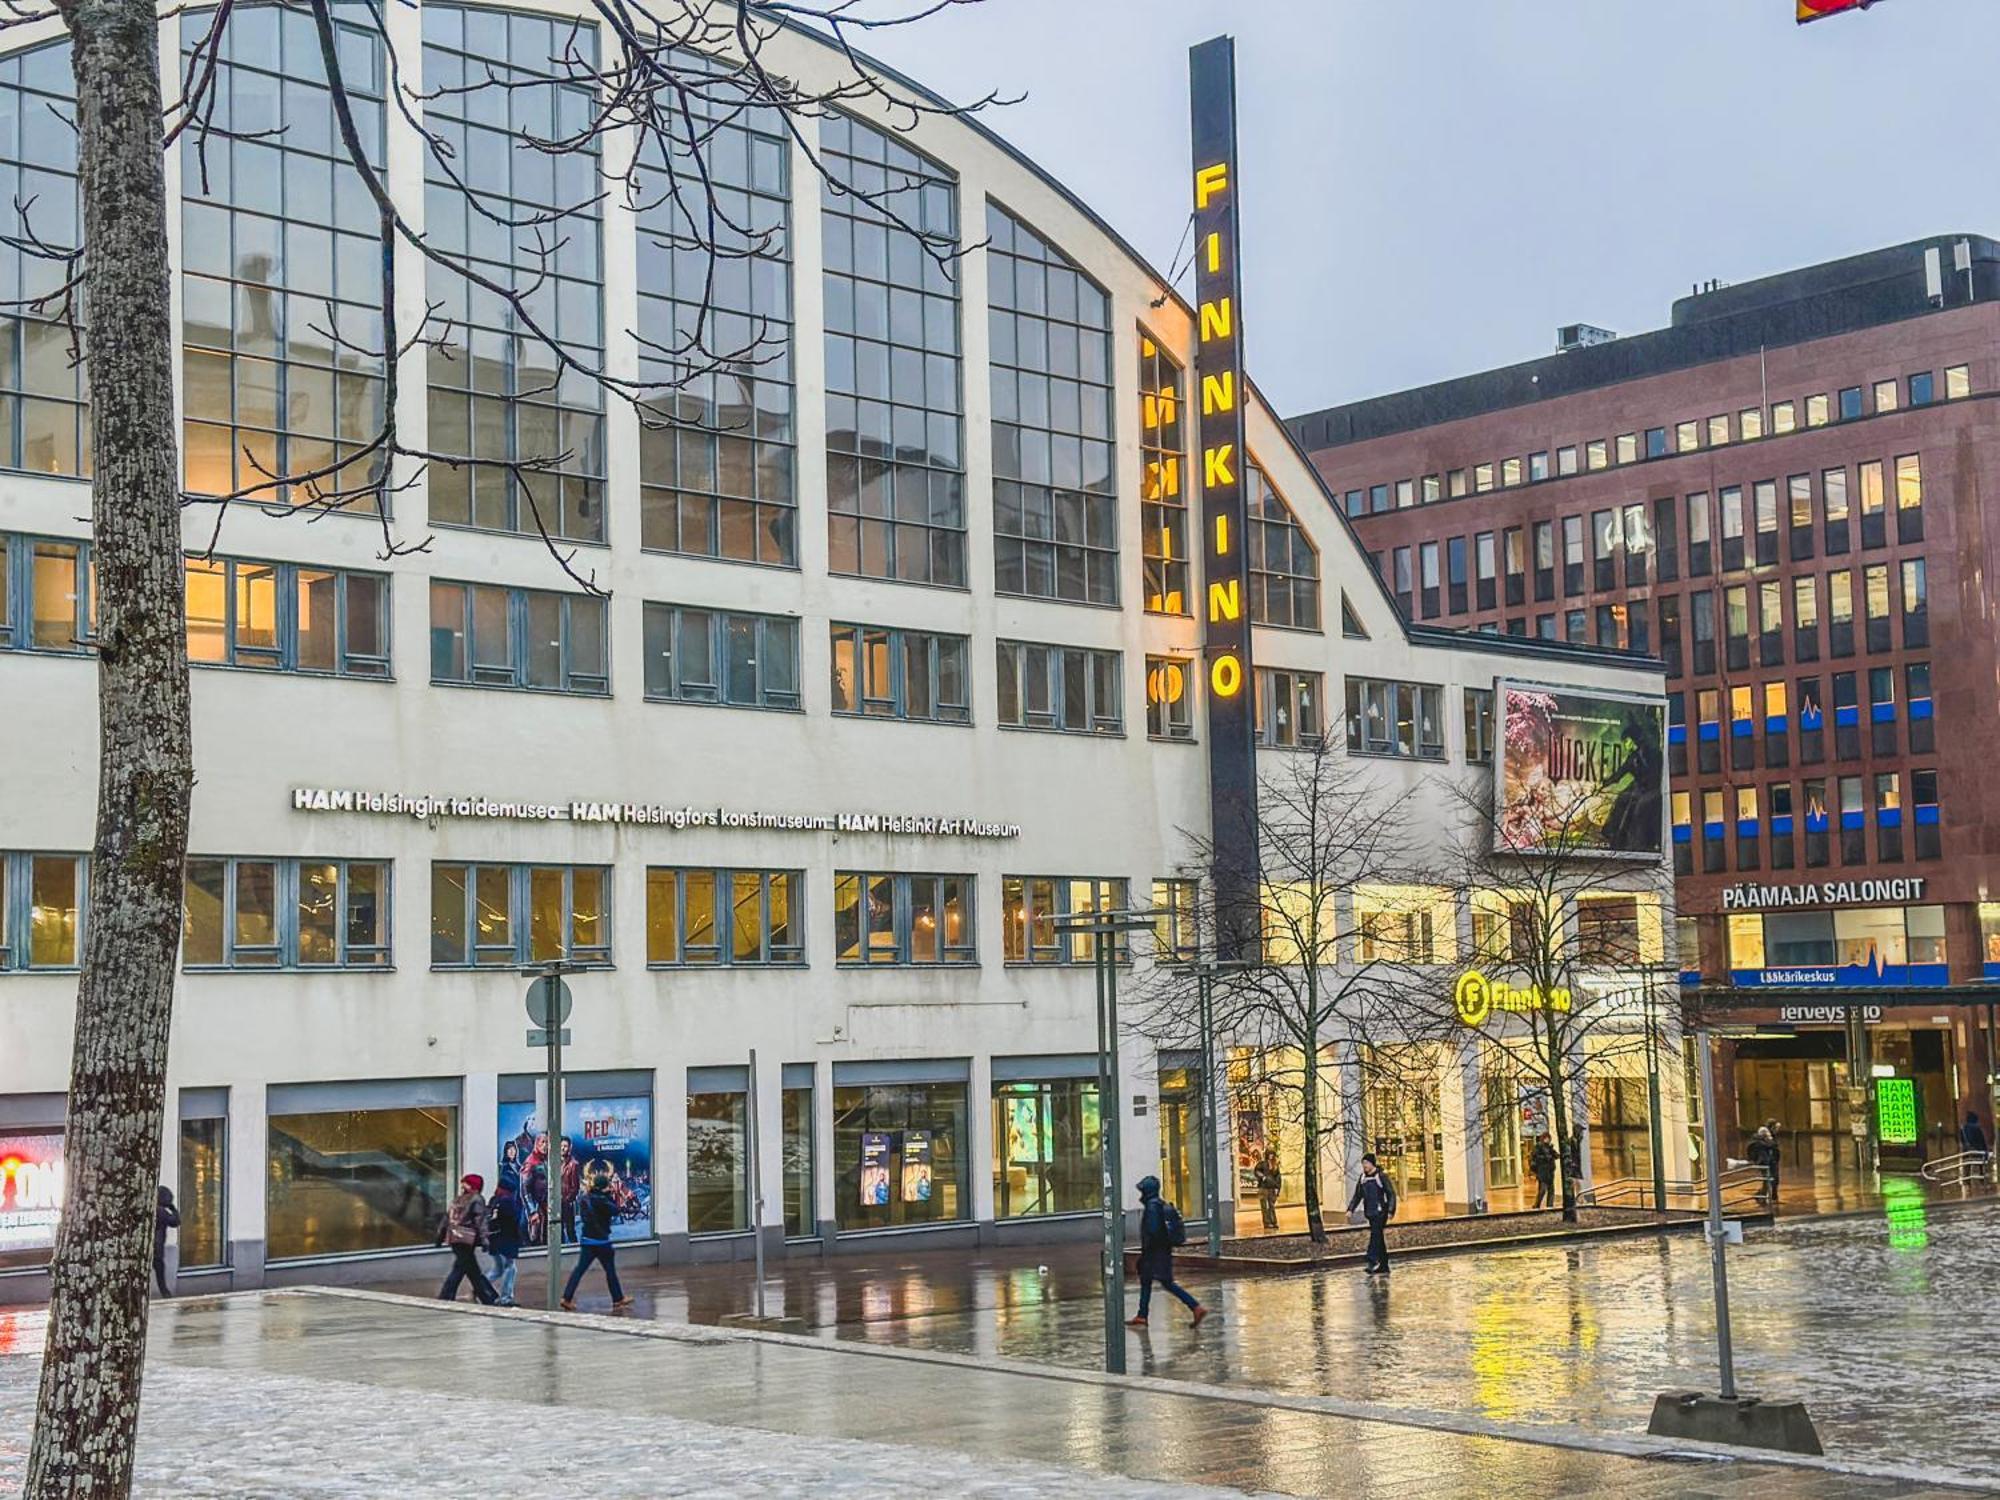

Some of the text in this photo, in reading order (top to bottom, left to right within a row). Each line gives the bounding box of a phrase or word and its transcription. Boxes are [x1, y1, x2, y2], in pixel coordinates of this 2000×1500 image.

[1196, 162, 1241, 698] FINNKINO
[1548, 733, 1622, 786] WICKED
[293, 788, 1022, 837] HAM Helsingin taidemuseo HAM Helsingfors konstmuseum HAM Helsinki Art Museum
[1723, 878, 1924, 908] PÄÄMAJA SALONGIT
[1760, 970, 1836, 984] Lääkärikeskus
[1880, 1082, 1911, 1091] HAM
[1881, 1093, 1912, 1101] HAM
[584, 1119, 609, 1140] RED
